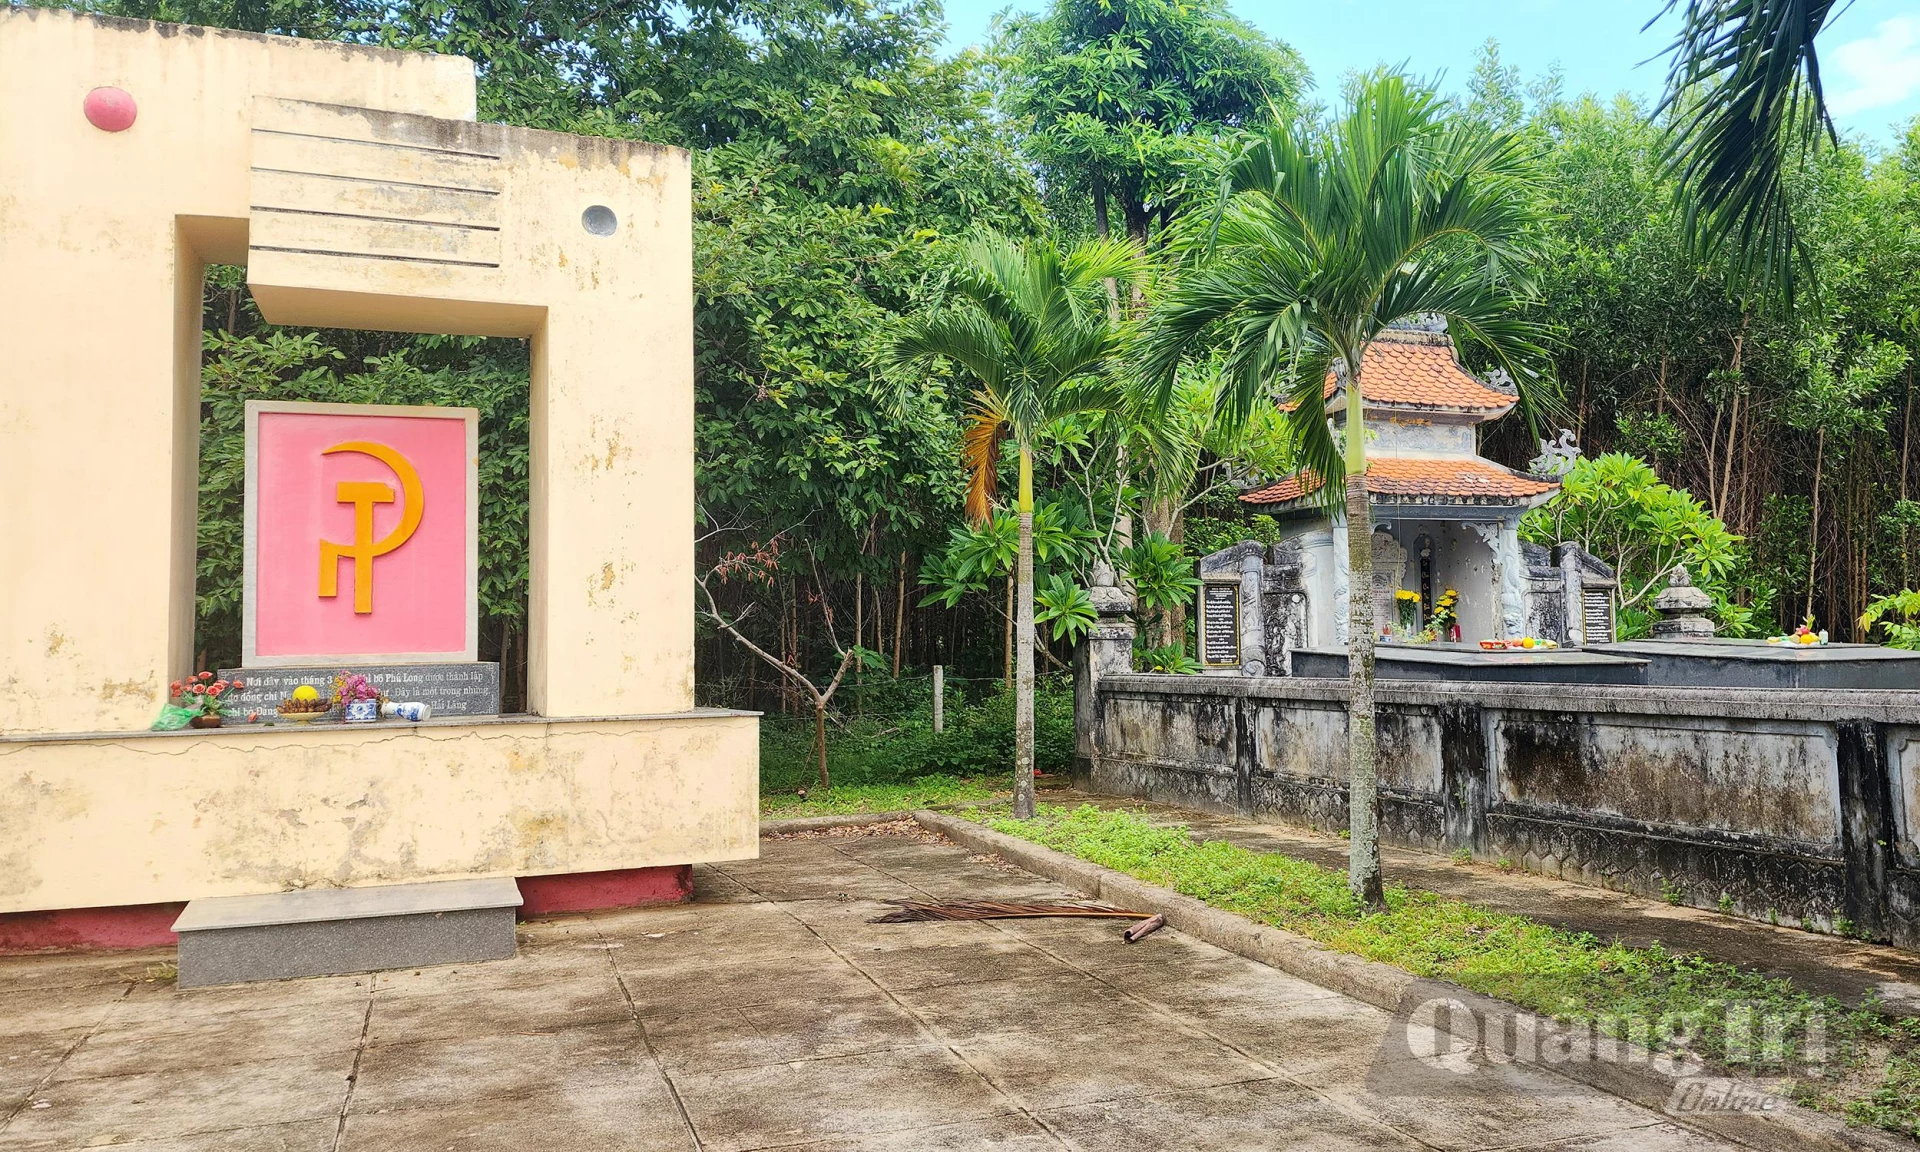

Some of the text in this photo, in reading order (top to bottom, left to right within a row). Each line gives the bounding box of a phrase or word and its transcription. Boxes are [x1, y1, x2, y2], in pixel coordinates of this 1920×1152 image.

[246, 676, 262, 686] Nơi
[283, 675, 299, 685] vào
[301, 674, 326, 687] tháng
[327, 675, 333, 684] 3
[385, 672, 402, 683] Phú
[403, 672, 424, 684] Long
[446, 671, 469, 681] thành
[263, 690, 278, 701] chí
[395, 686, 411, 698] Đây
[440, 687, 462, 698] trong
[257, 704, 278, 718] Đảng
